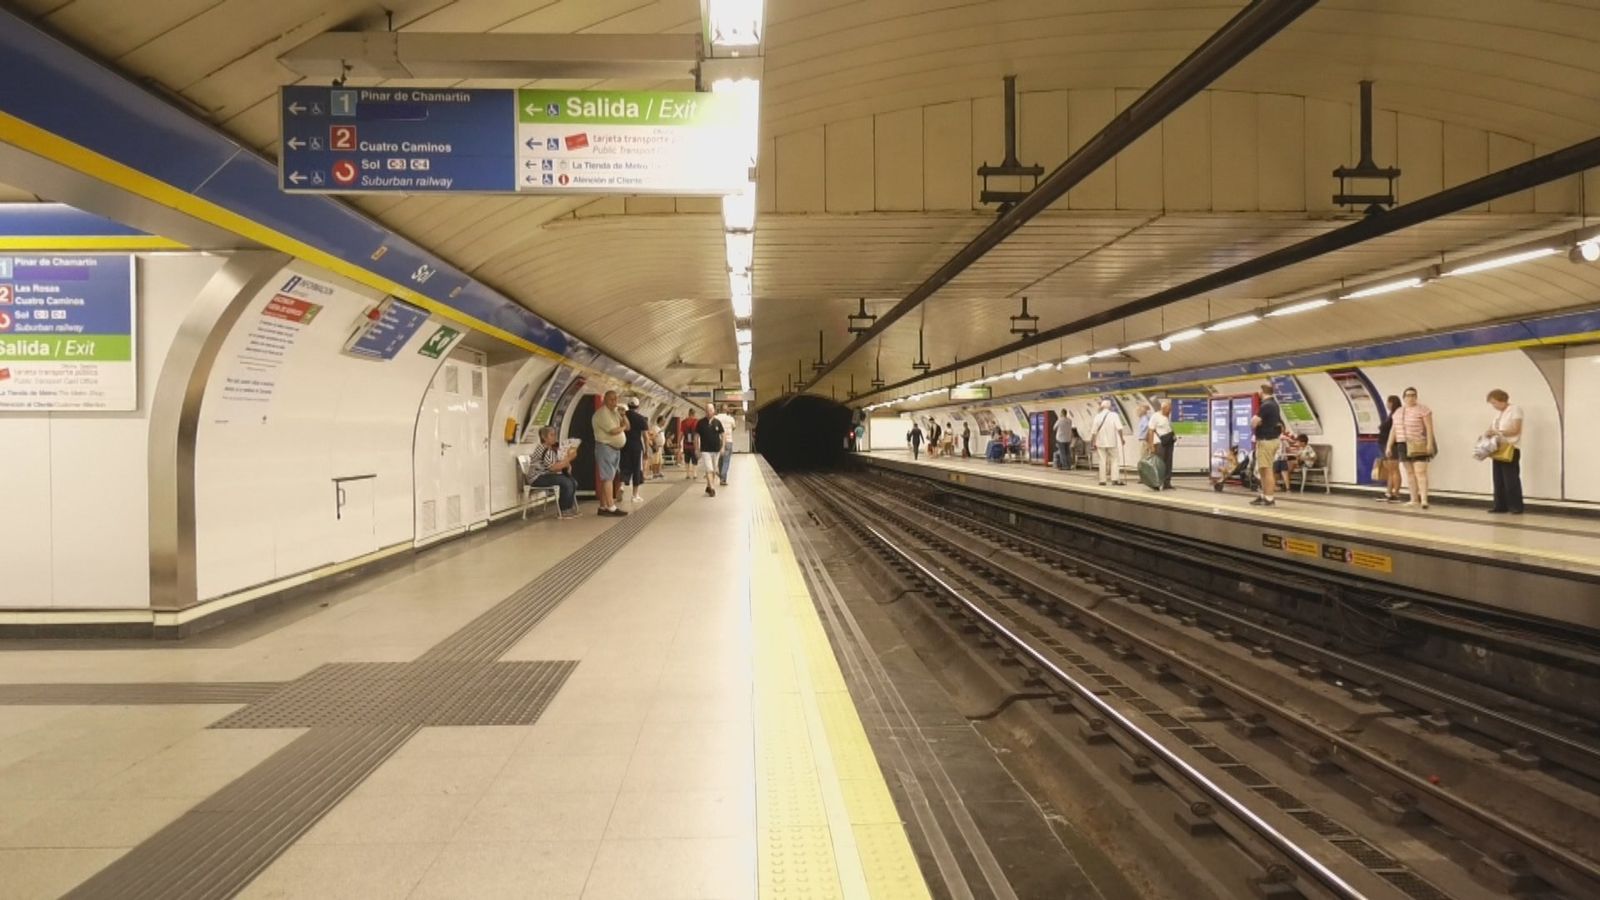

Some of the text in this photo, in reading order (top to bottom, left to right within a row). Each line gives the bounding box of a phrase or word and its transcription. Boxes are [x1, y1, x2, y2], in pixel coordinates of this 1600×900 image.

[361, 92, 390, 101] Pinar
[394, 92, 408, 101] de
[339, 93, 349, 113] 1
[566, 97, 698, 120] Salida / Exit
[337, 129, 350, 148] 2
[592, 135, 622, 145] tarjeta
[360, 142, 451, 153] Cuatro Caminos
[361, 160, 380, 170] Sol
[572, 161, 582, 169] La
[584, 161, 611, 169] Tienda
[613, 161, 623, 169] de
[361, 174, 452, 189] Suburban railway
[14, 256, 38, 266] Pinar
[39, 256, 51, 266] de
[411, 264, 436, 284] Sol
[0, 285, 9, 302] 2
[15, 284, 60, 293] Las Rosas
[15, 296, 85, 306] Cuatro Caminos
[14, 310, 29, 320] Sol
[54, 340, 62, 358] /
[65, 340, 95, 356] Exit
